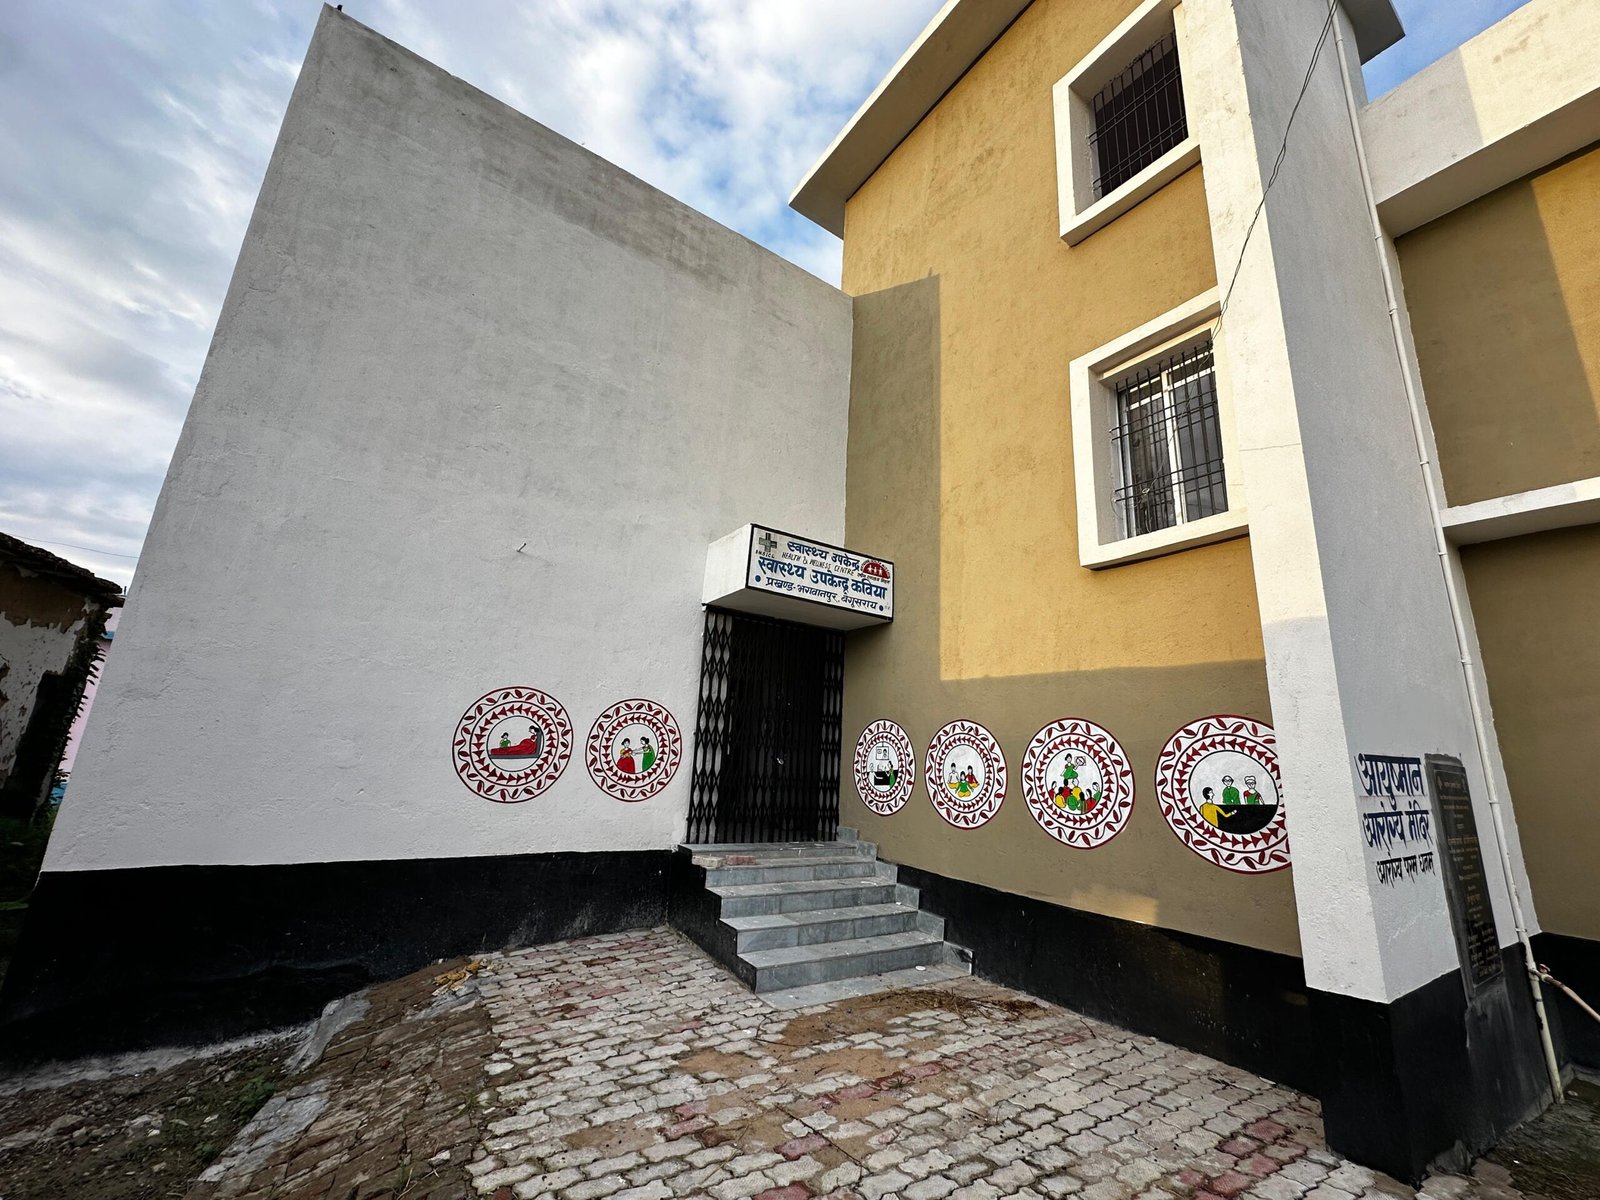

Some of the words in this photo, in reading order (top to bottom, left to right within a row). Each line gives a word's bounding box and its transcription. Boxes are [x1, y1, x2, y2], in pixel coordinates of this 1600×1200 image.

[781, 551, 801, 562] HEALTH
[802, 556, 808, 565] &
[809, 558, 832, 570] WELLNESS
[834, 564, 855, 577] CENTRE
[787, 541, 829, 560] स्वास्थ्य
[831, 553, 861, 571] उपकेन्द्र
[758, 556, 807, 579] स्वास्थ्य
[851, 578, 888, 599] कविया
[1354, 753, 1425, 811] आयुष्मान
[1362, 801, 1407, 851] आरोग्य
[1405, 800, 1433, 849] मंदिर
[1376, 851, 1404, 888] आरोग्य
